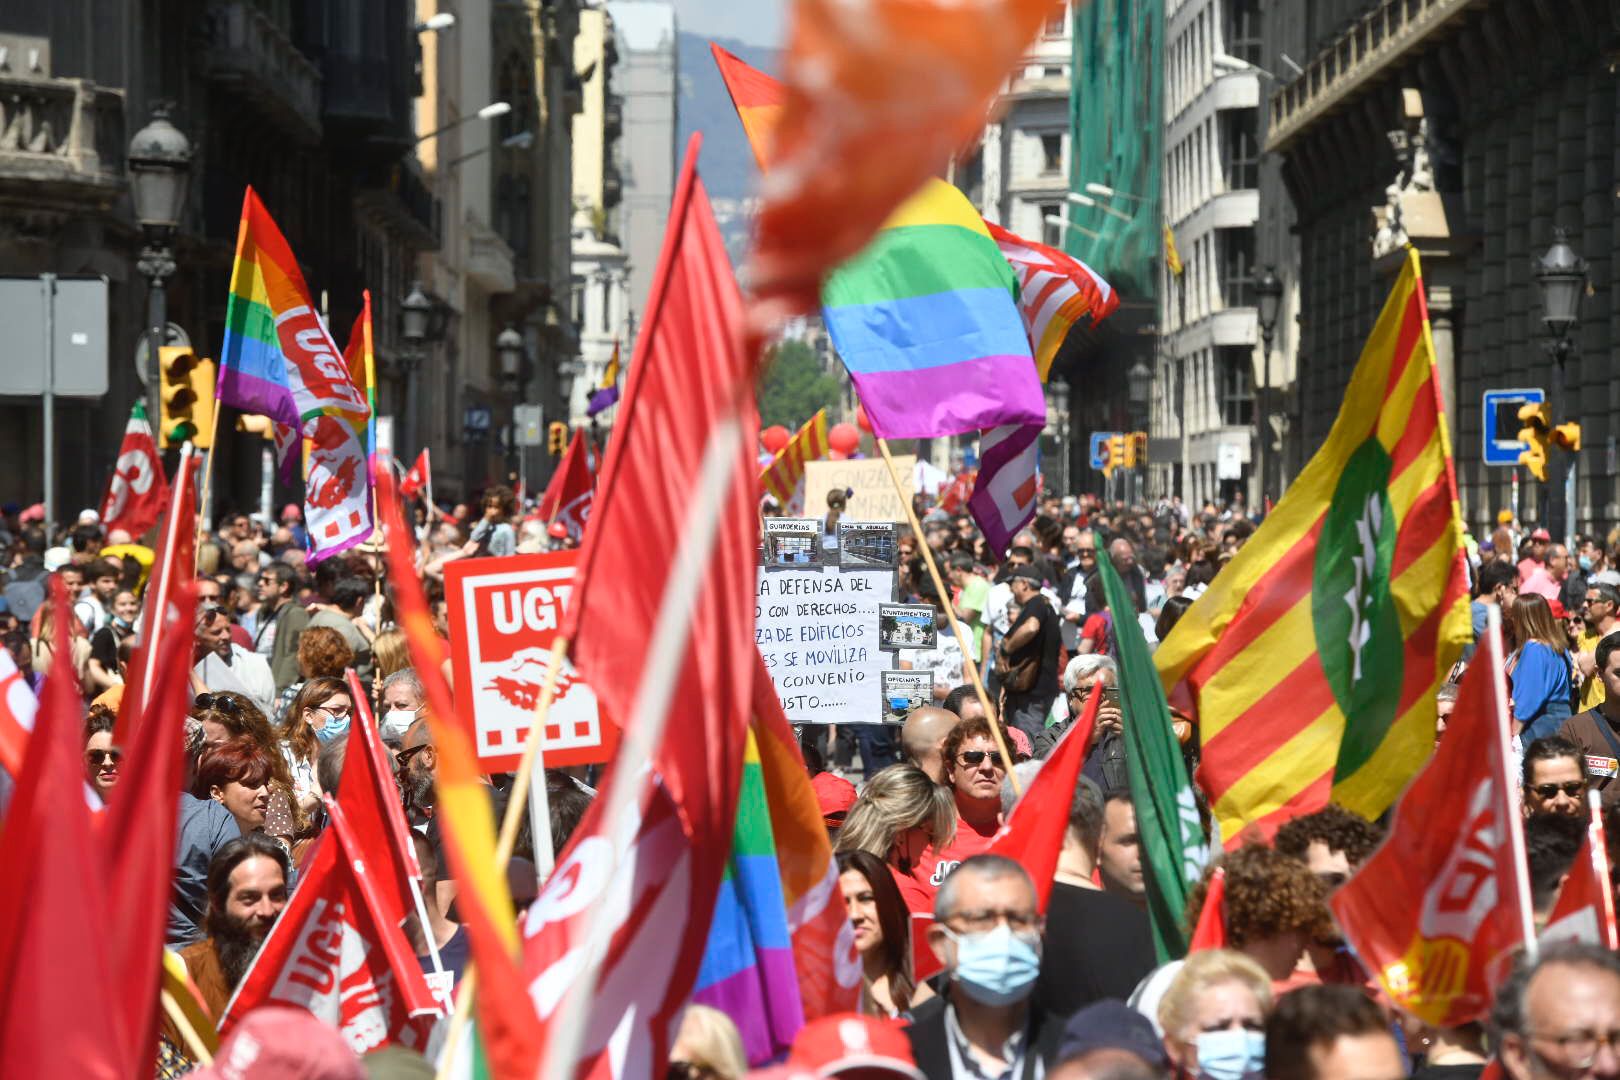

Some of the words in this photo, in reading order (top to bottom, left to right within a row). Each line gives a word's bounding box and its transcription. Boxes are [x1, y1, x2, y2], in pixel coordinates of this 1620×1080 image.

[780, 578, 843, 595] DEFENSA
[851, 578, 872, 592] DEL
[769, 605, 788, 618] CON
[777, 627, 793, 642] DE
[801, 622, 865, 642] EDIFICIOS
[785, 652, 798, 667] SE
[806, 644, 867, 666] MOVILIZA
[783, 669, 865, 688] CONVENIO
